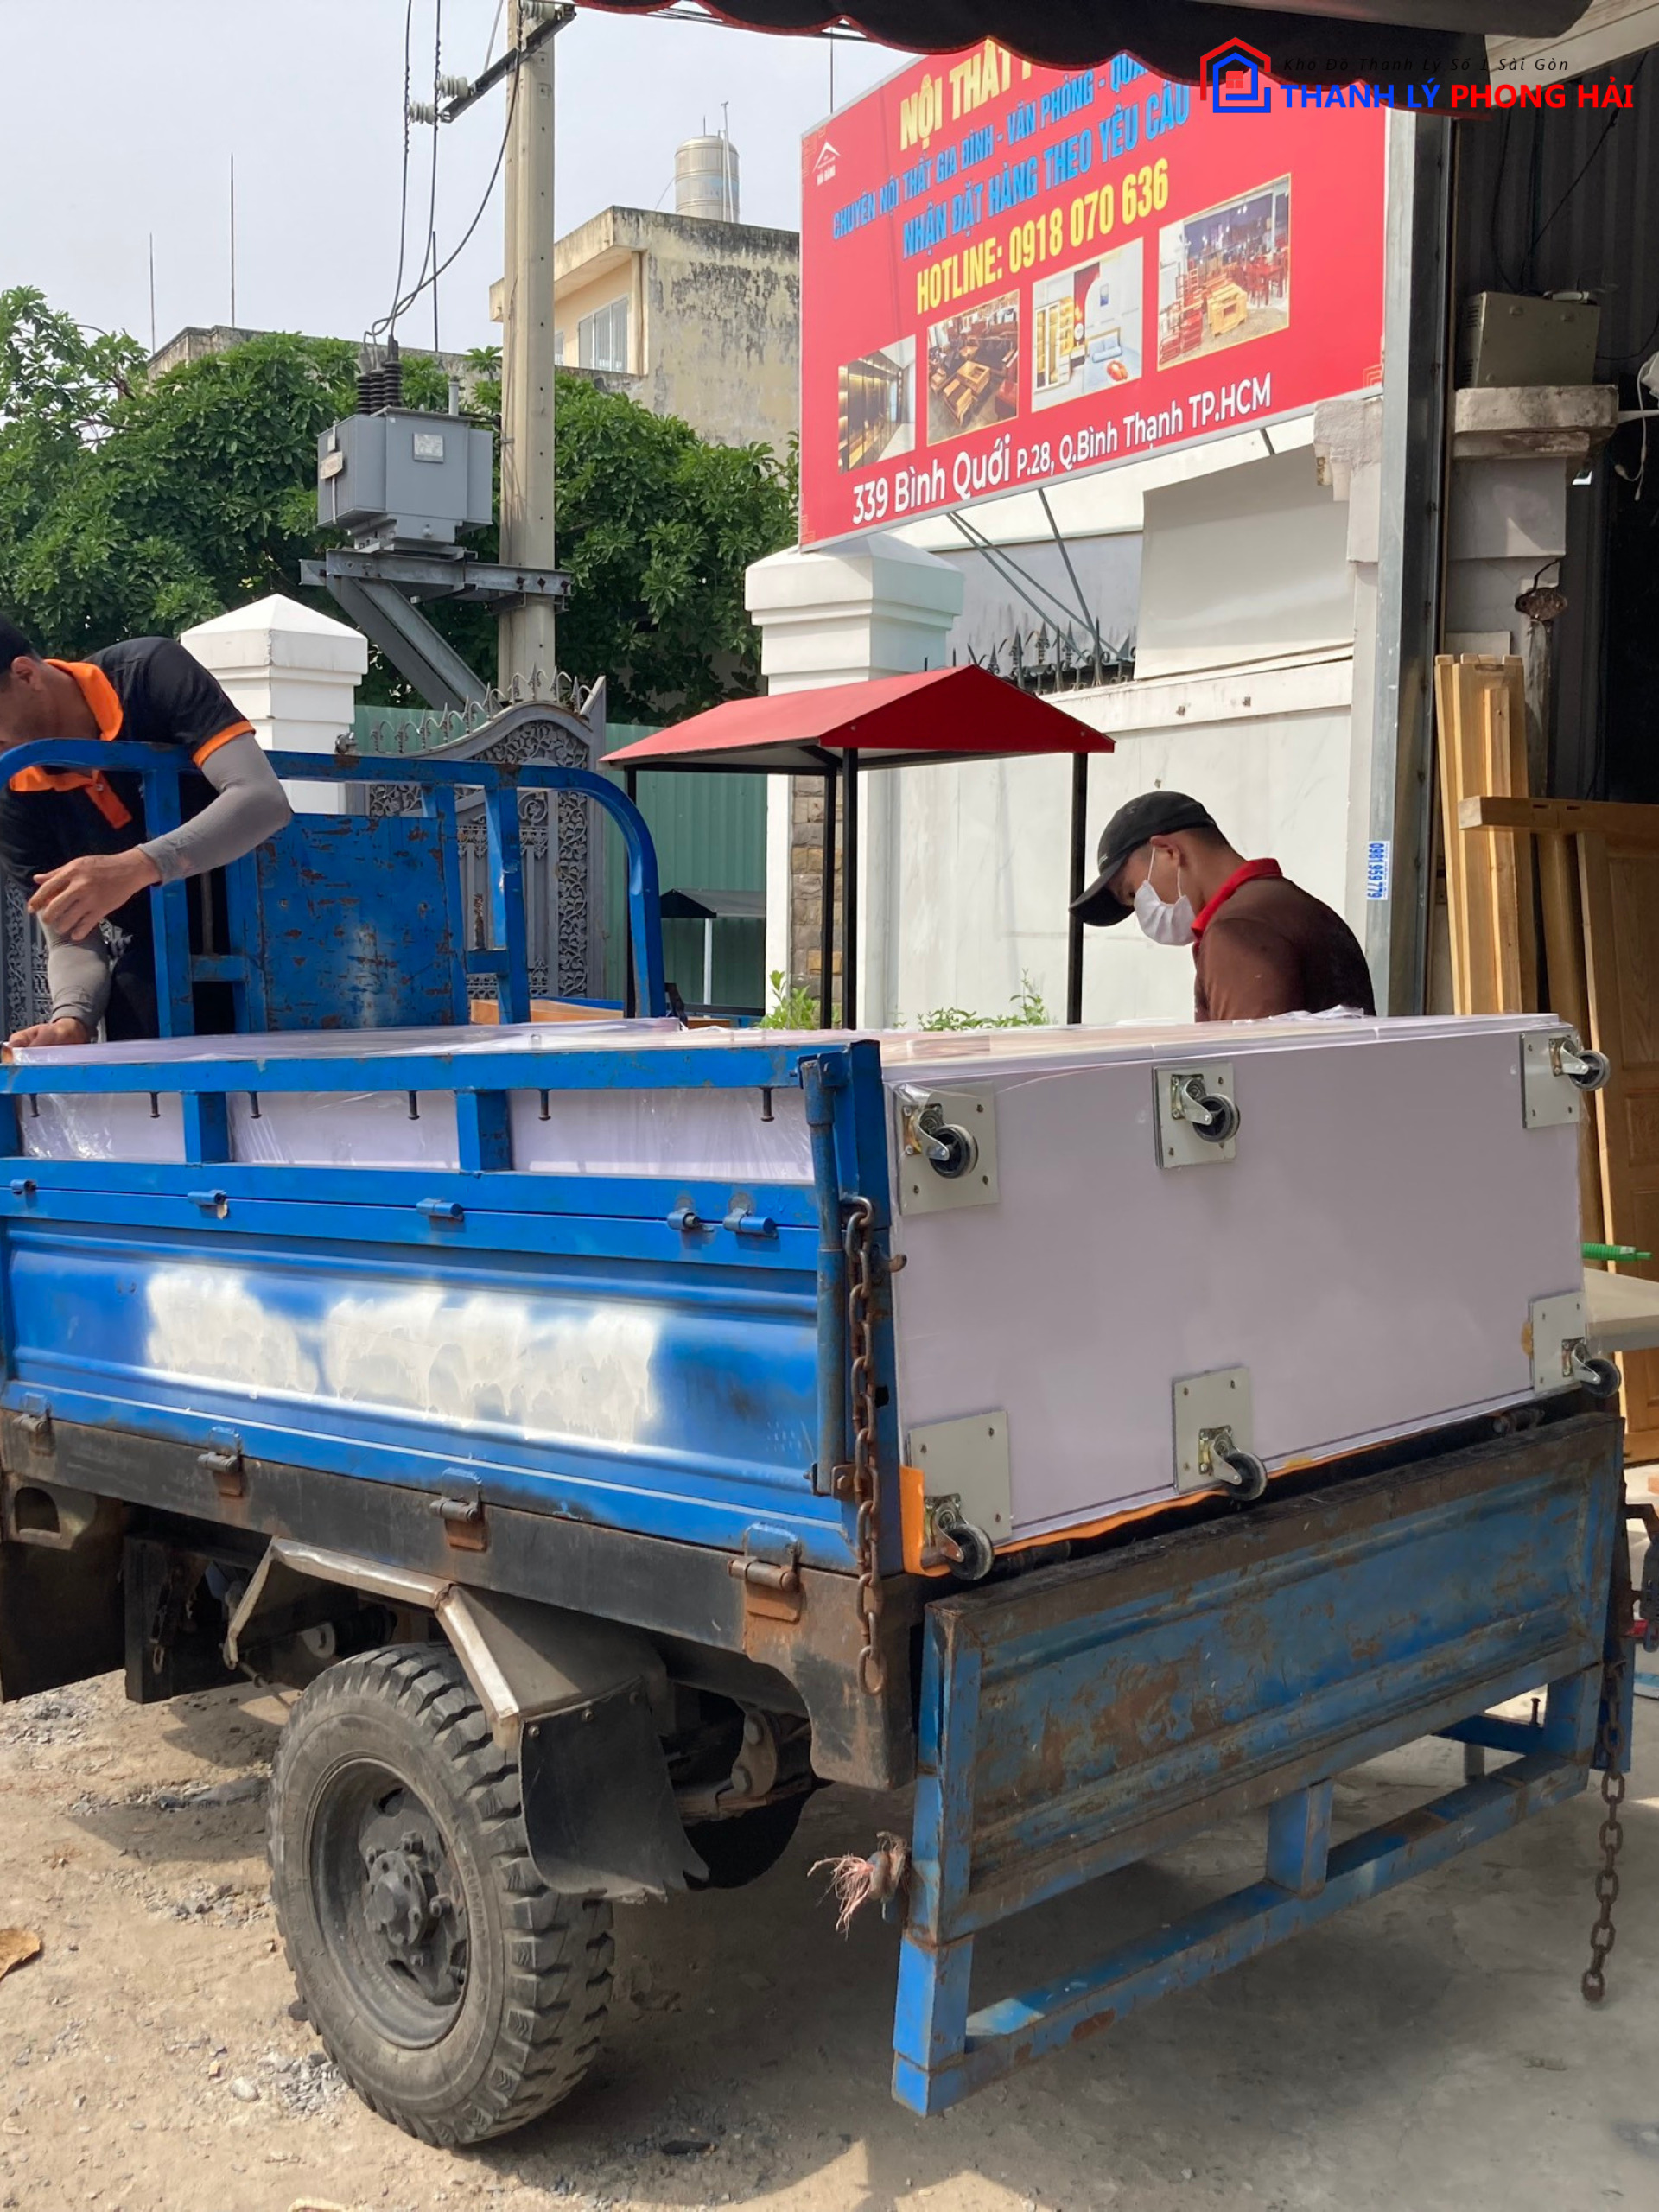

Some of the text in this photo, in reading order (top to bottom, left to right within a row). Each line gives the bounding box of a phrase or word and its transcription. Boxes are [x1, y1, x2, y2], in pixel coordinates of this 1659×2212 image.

[832, 190, 876, 241] CHUYÊN
[879, 175, 899, 217] NỘI
[902, 150, 932, 202] THẤT
[936, 143, 957, 184] GIA
[961, 124, 994, 171] ĐÌNH
[1007, 101, 1036, 146] VĂN
[1040, 69, 1094, 130] PHÒNG
[1110, 54, 1148, 93] QU
[900, 73, 943, 151] NỘI
[903, 200, 947, 261] NHẬN
[951, 179, 984, 238] ĐẶT
[988, 156, 1038, 218] HÀNG
[1043, 129, 1093, 190] THEO
[1099, 103, 1139, 163] YÊU
[917, 157, 1168, 315] HOTLINE: 0918 070 636
[852, 372, 1271, 524] 339 Bình Quới P.28, Q.Bình Thạnh TP.HCM
